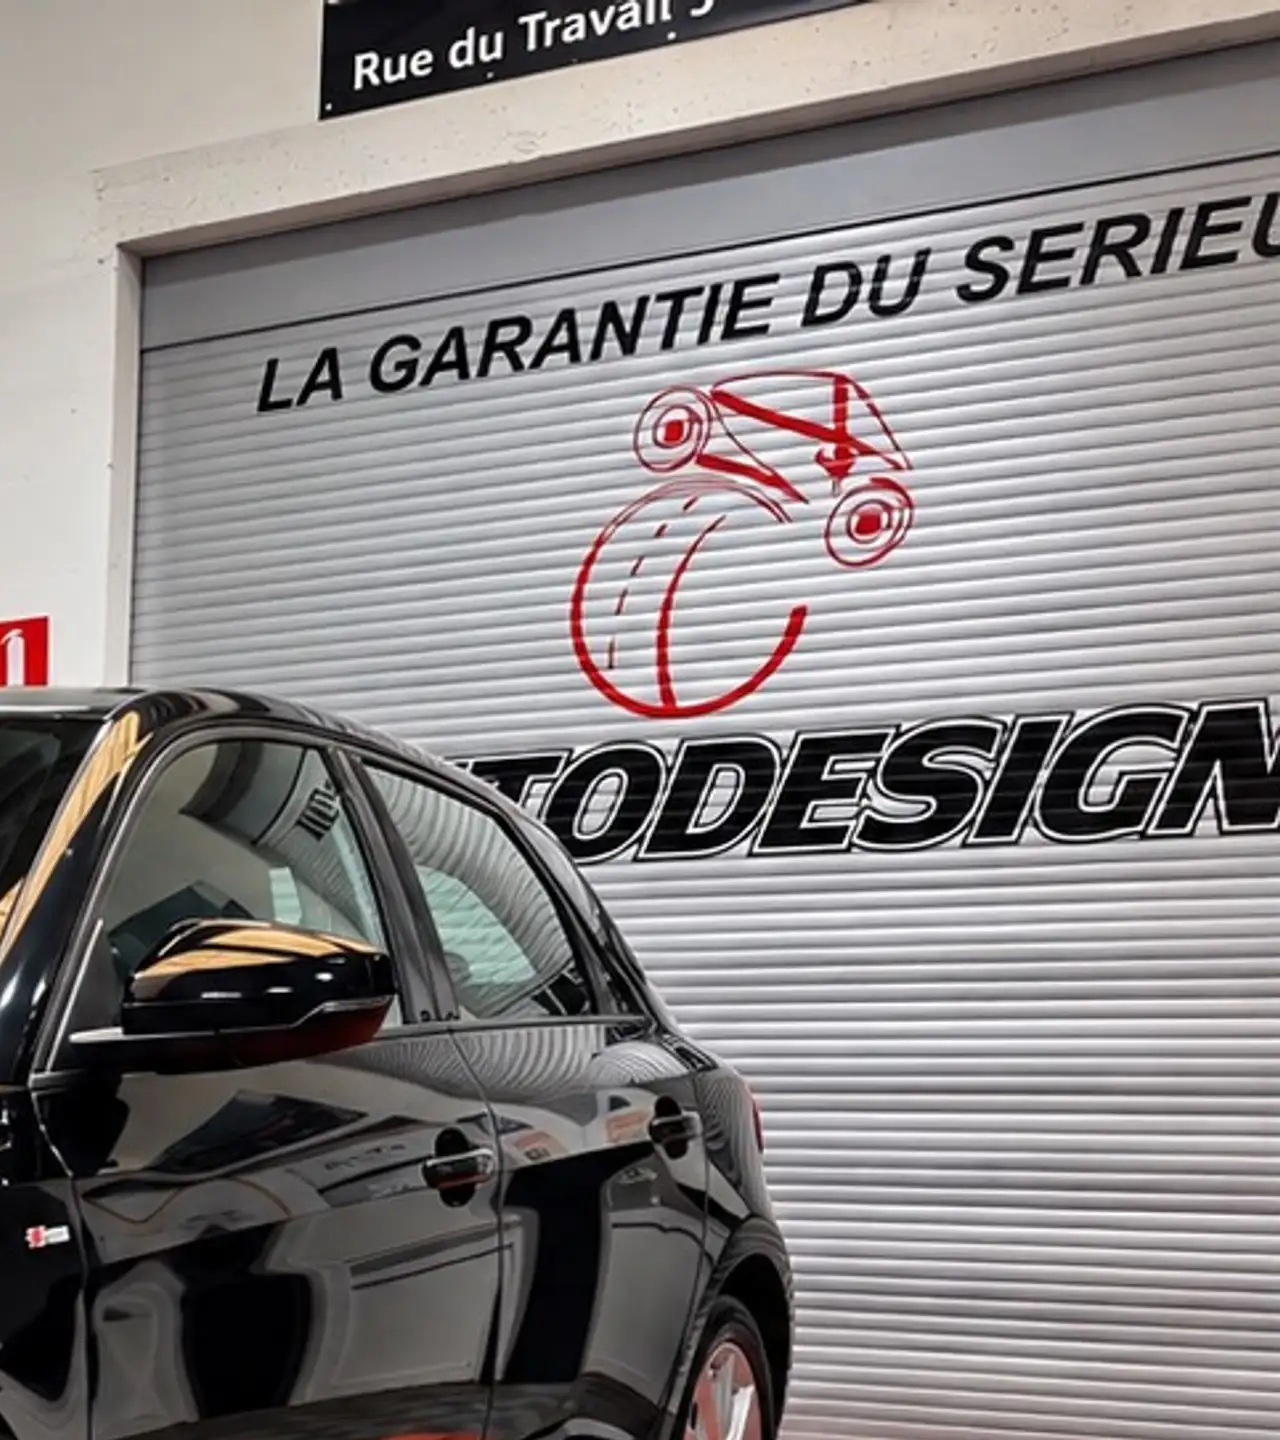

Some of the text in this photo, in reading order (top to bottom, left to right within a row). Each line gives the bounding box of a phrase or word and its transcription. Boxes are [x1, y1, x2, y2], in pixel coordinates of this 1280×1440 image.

[353, 49, 434, 90] Rue
[448, 26, 504, 69] du
[256, 347, 343, 412] LA
[368, 273, 780, 393] GARANTIE
[800, 247, 932, 328] DU
